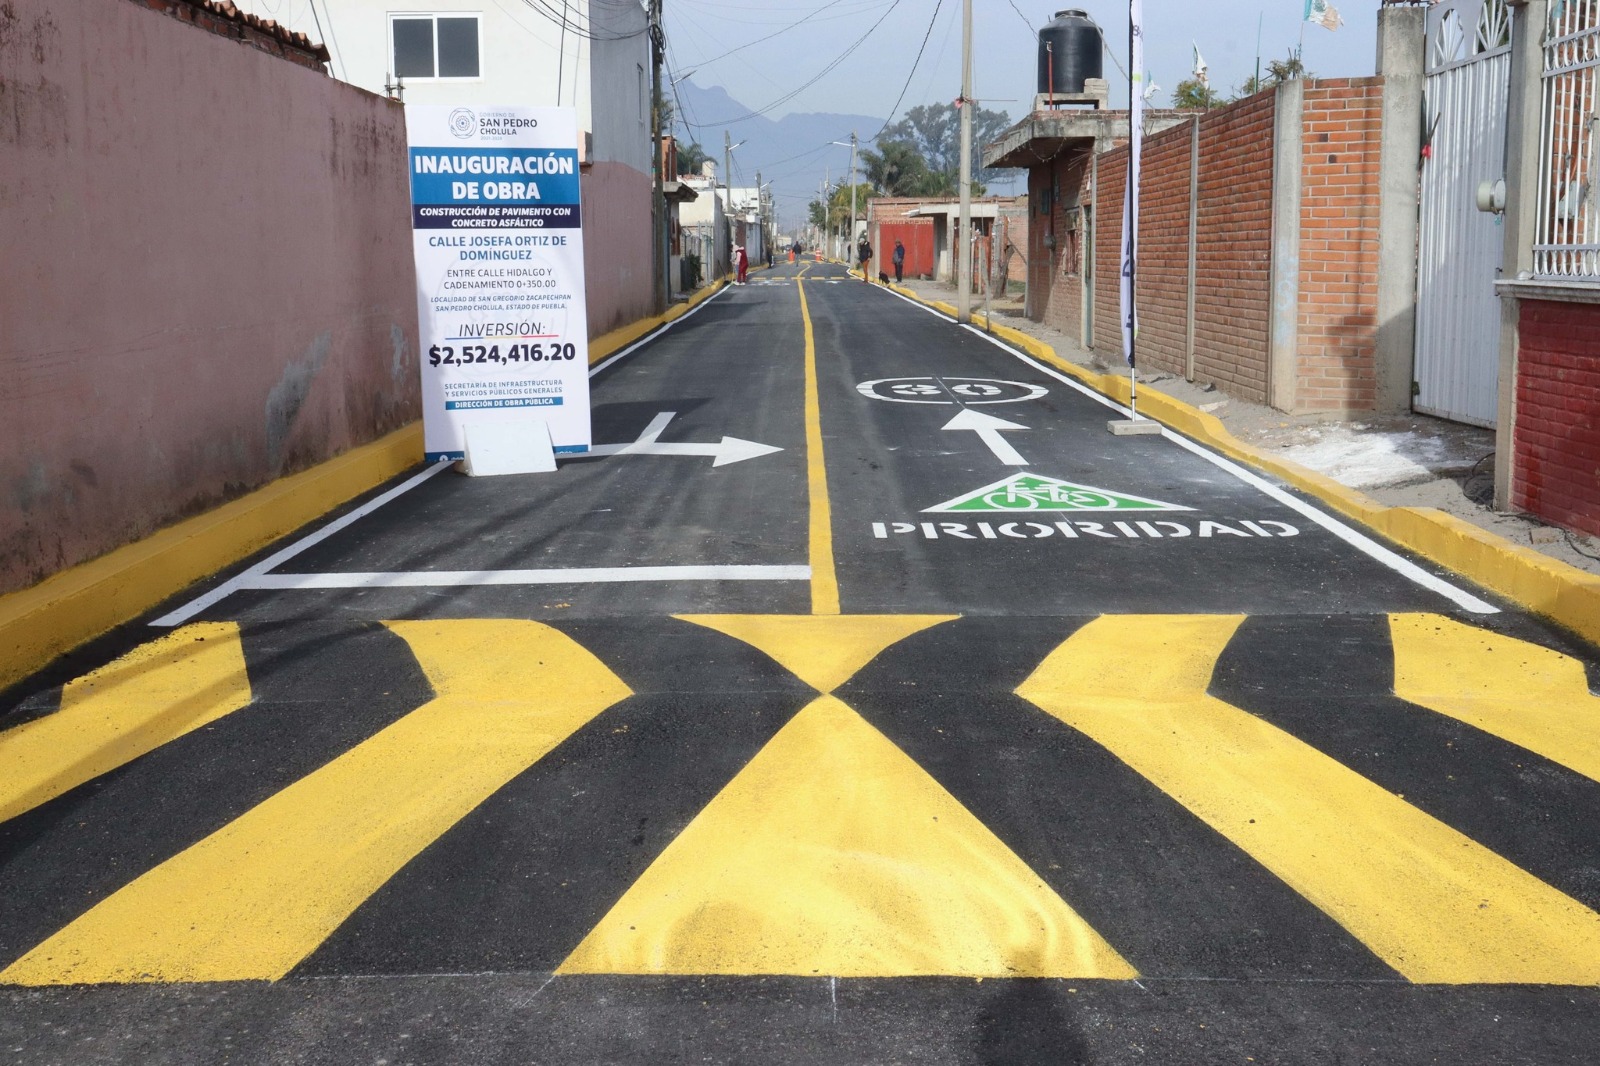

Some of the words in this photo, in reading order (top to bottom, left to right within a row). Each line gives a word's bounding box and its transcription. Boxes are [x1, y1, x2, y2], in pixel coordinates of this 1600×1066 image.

[480, 118, 500, 127] SAN
[504, 118, 538, 128] PEDRO
[415, 152, 573, 174] INAUGURACIÓN
[452, 182, 478, 199] DE
[483, 182, 540, 200] OBRA
[420, 206, 487, 216] CONSTRUCCIÓN
[489, 208, 500, 216] DE
[502, 208, 550, 216] PAVIMENTO
[552, 208, 570, 216] CON
[452, 219, 498, 227] CONCRETO
[499, 218, 544, 227] ASFÁLTICO
[429, 236, 466, 247] CALLE
[469, 236, 512, 246] JOSEFA
[515, 236, 548, 246] ORTIZ
[552, 236, 566, 246] DE
[460, 248, 532, 260] DOMÍNGUEZ
[447, 269, 475, 277] ENTRE
[478, 269, 504, 277] CALLE
[507, 268, 545, 277] HIDALGO
[444, 280, 514, 289] CADENAMIENTO
[517, 280, 556, 288] 0+350.00
[459, 320, 546, 337] INVERSIÓN:
[429, 343, 576, 367] $2,524,416.20
[445, 381, 487, 389] SECRETARÍA
[891, 384, 1002, 396] 30
[455, 400, 492, 408] DIRECCIÓN
[872, 520, 1300, 540] PRIORIDAD
